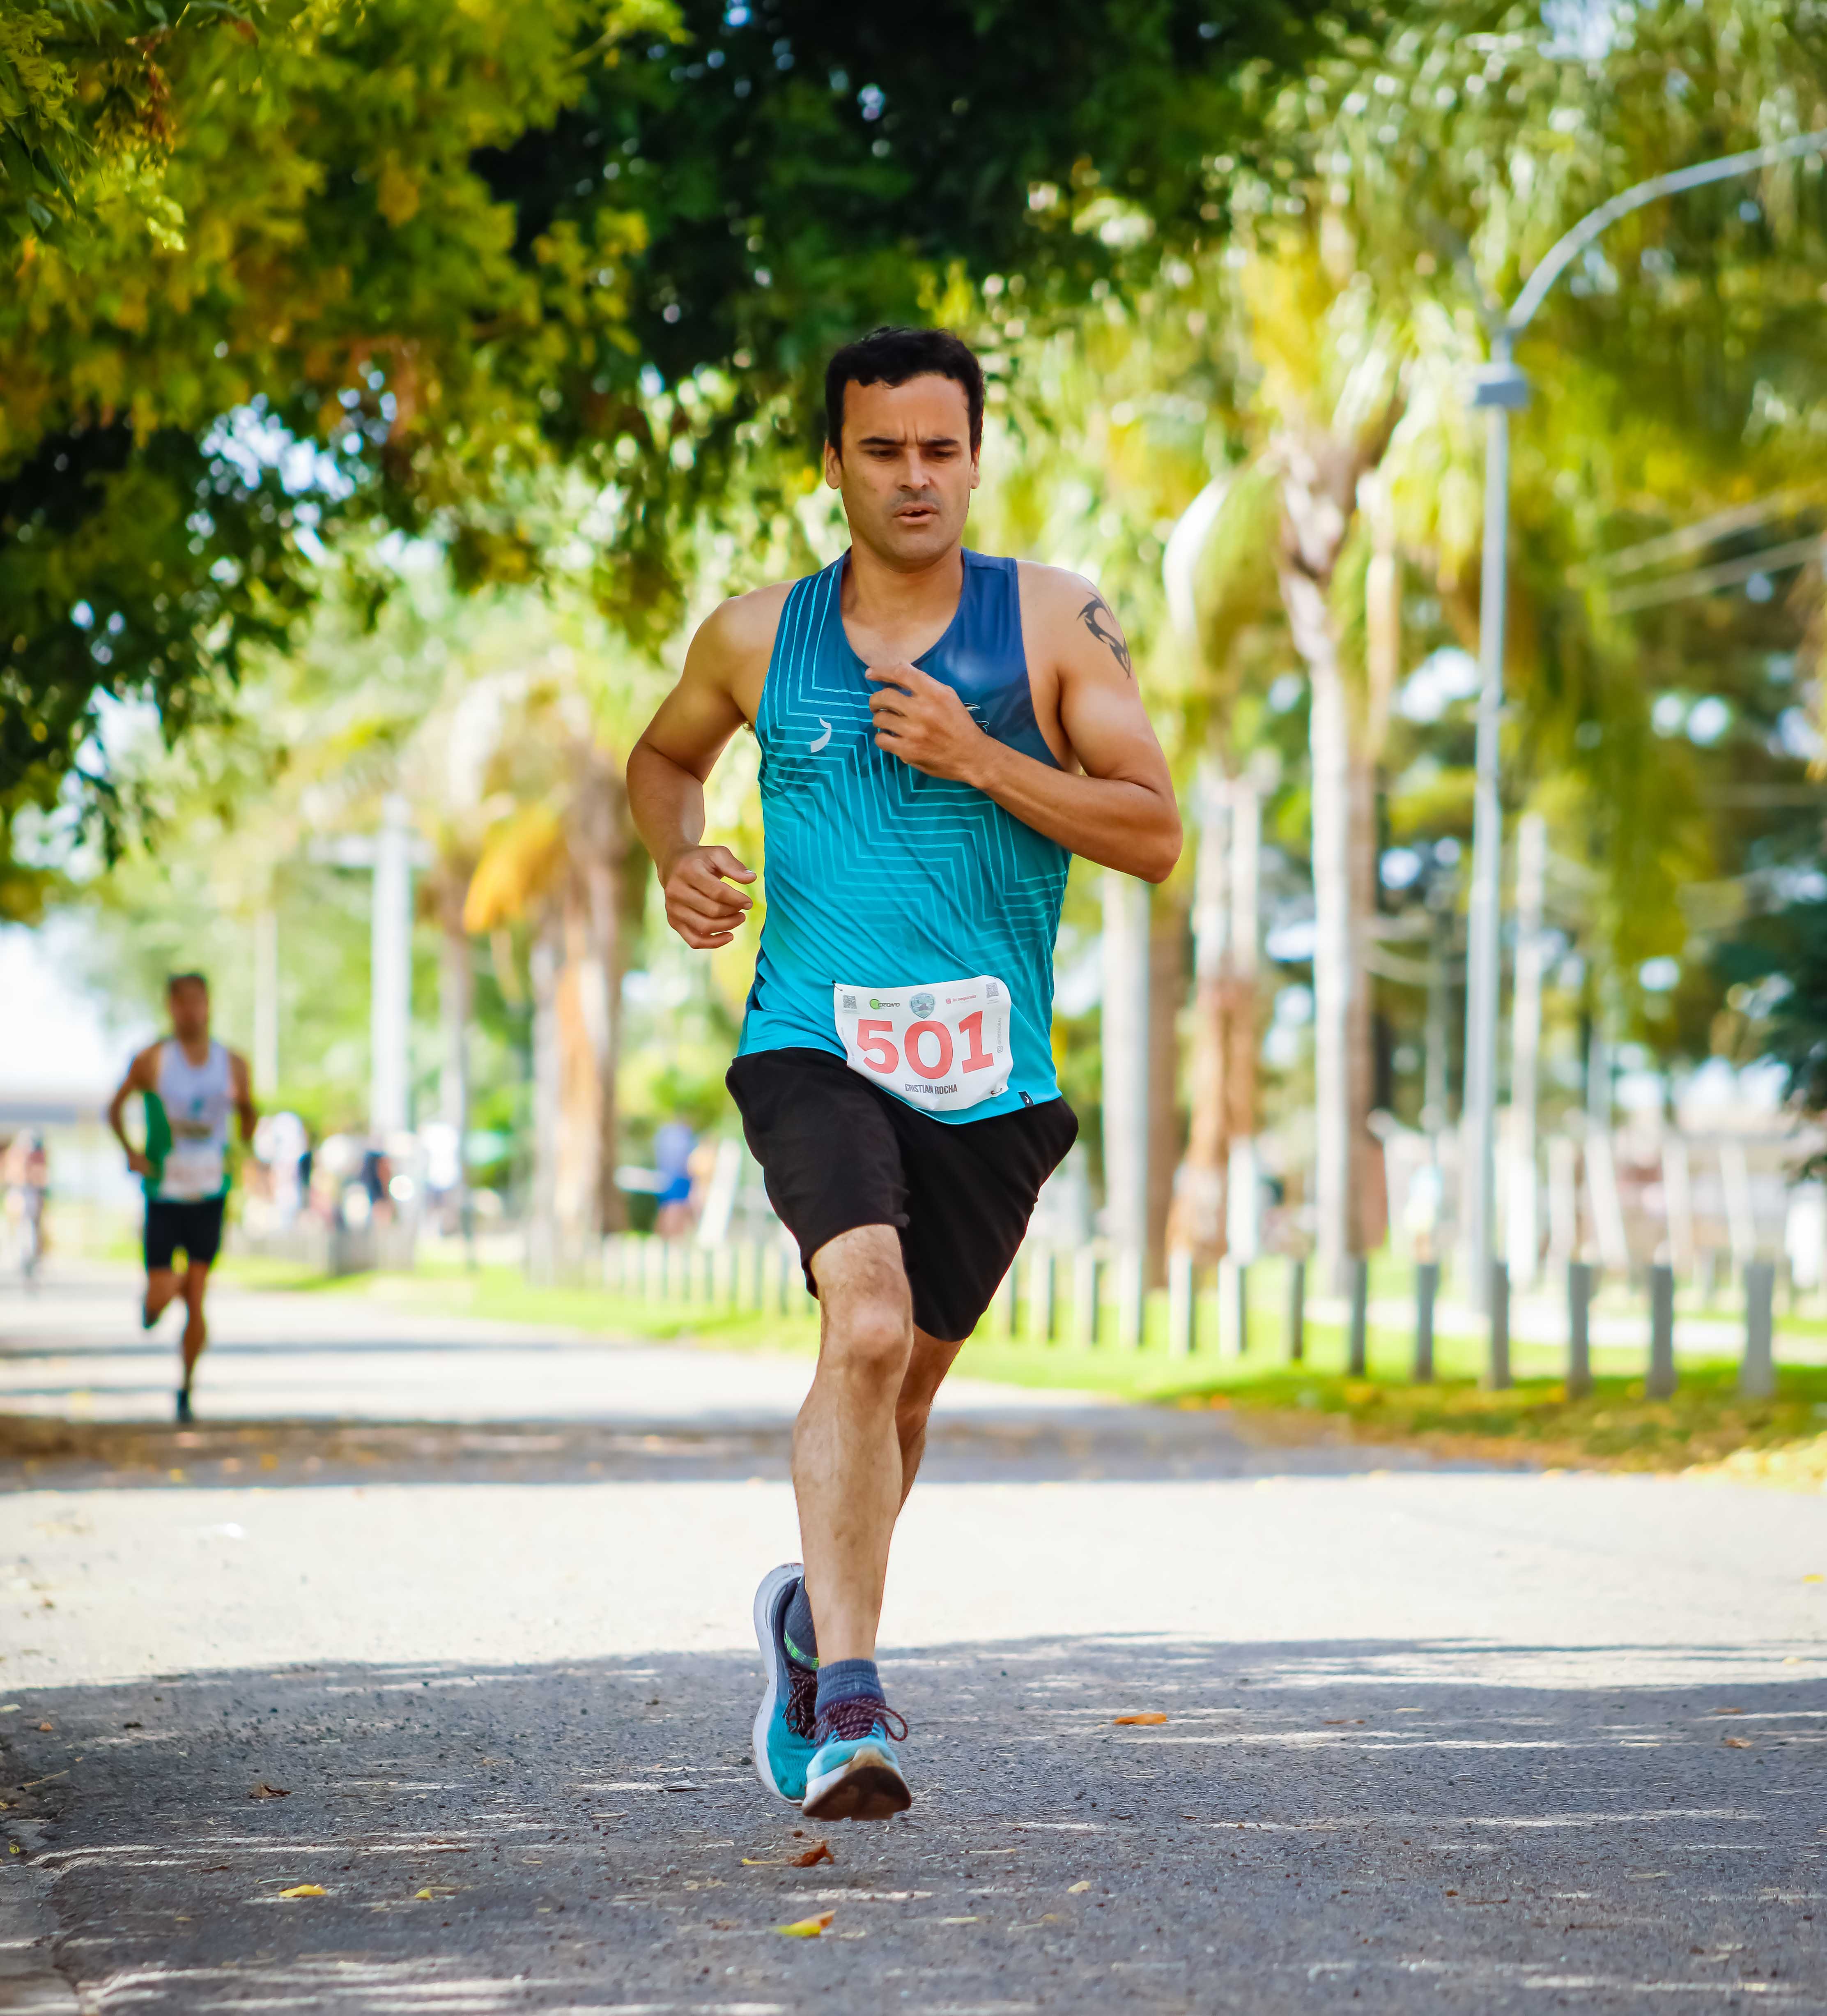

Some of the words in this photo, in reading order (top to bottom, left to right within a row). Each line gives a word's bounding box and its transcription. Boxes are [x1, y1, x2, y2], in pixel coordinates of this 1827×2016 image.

[857, 1010, 994, 1079] 501
[905, 1084, 933, 1093] CRISTIAN
[934, 1084, 958, 1095] ROCHA
